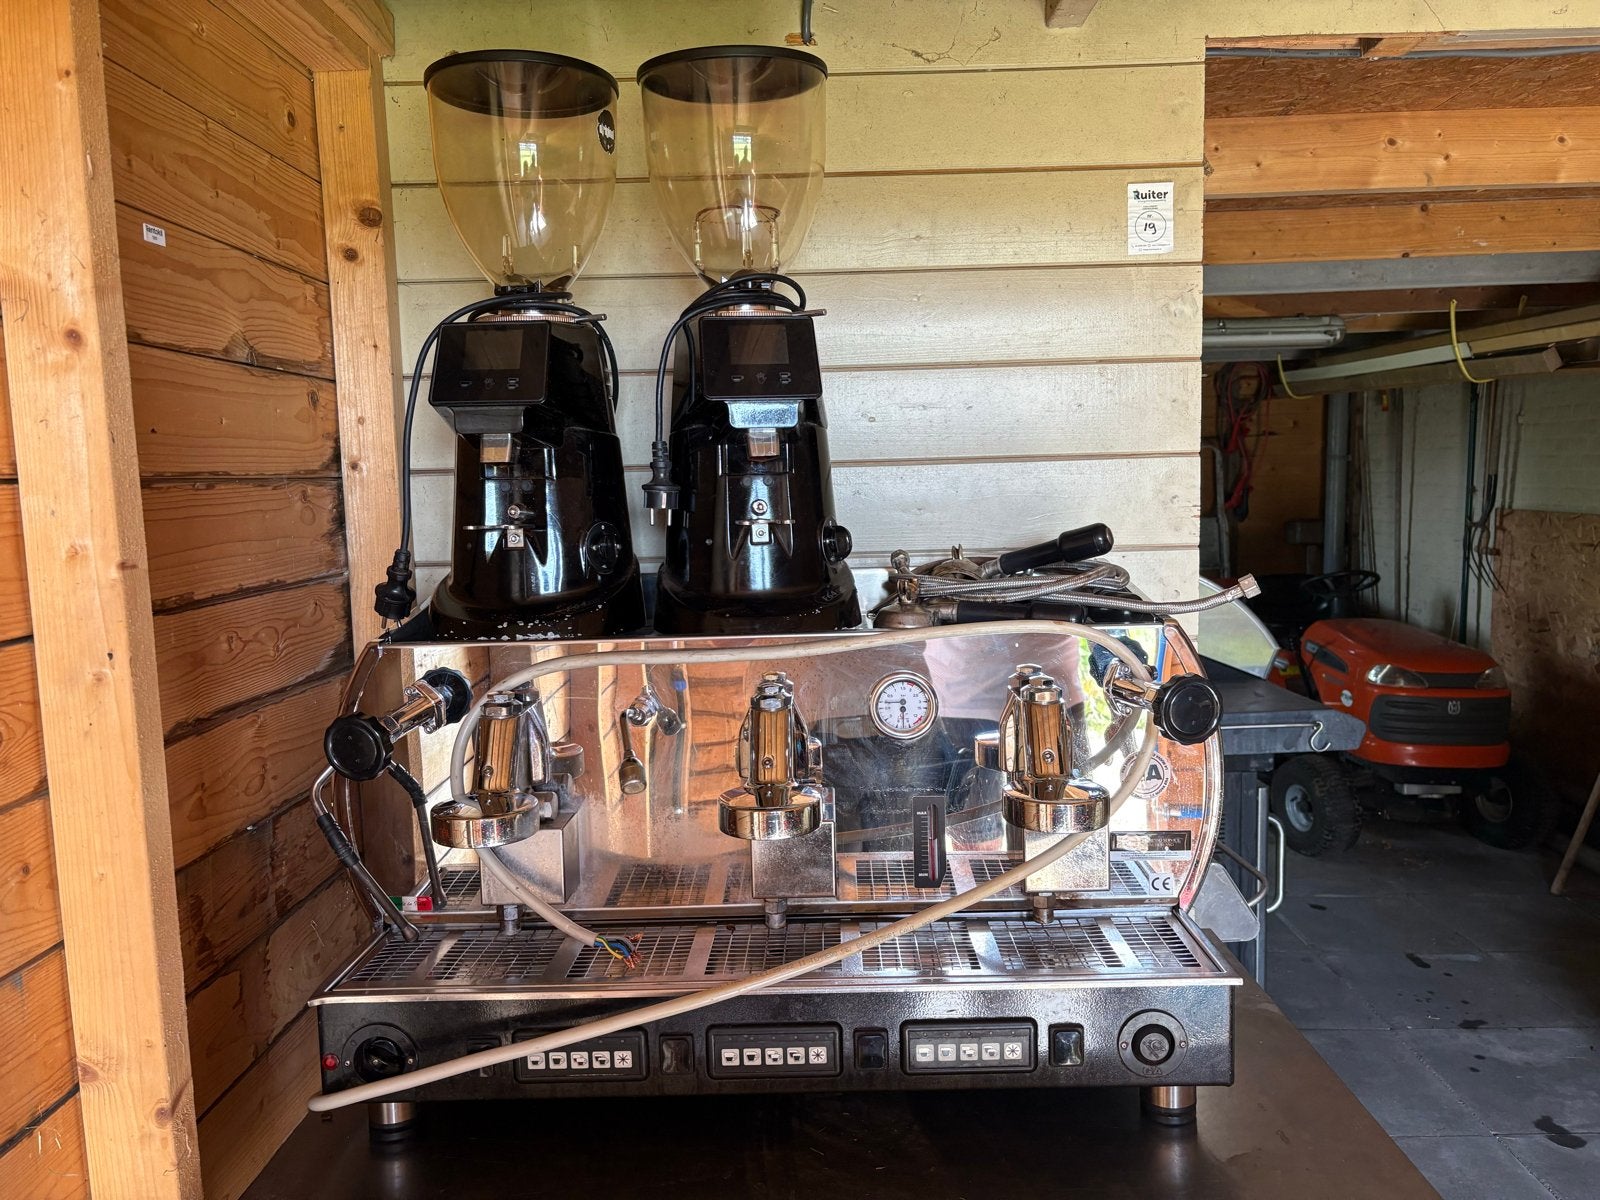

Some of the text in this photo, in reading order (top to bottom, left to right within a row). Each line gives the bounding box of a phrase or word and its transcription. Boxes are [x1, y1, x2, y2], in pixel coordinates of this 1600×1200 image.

[1132, 189, 1169, 200] Ruiter
[1144, 222, 1157, 235] 19
[1151, 877, 1171, 891] CE
